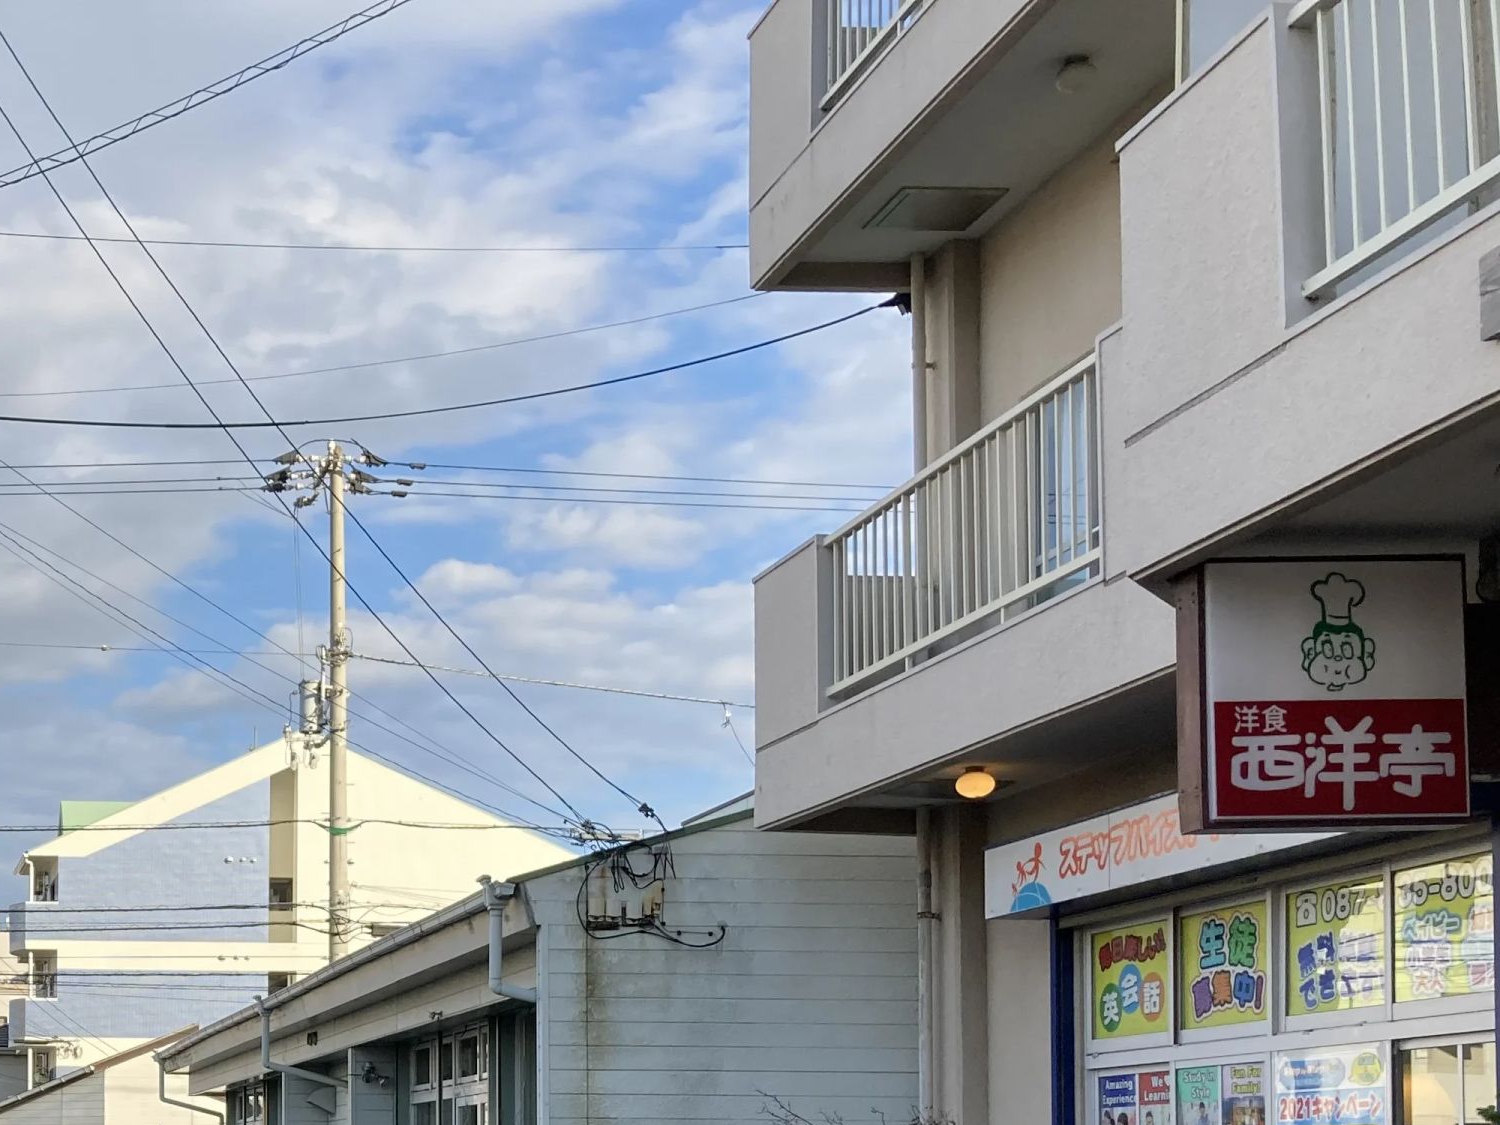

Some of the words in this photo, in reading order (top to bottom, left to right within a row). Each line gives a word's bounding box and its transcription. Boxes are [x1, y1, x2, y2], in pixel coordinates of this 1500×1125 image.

[1234, 704, 1288, 733] 洋食
[1231, 715, 1456, 812] 西洋亭
[1199, 914, 1258, 970] 生徒
[1151, 1076, 1164, 1088] We
[1184, 1071, 1205, 1084] Study
[1105, 1079, 1133, 1091] Amazing
[1191, 1086, 1210, 1099] Style
